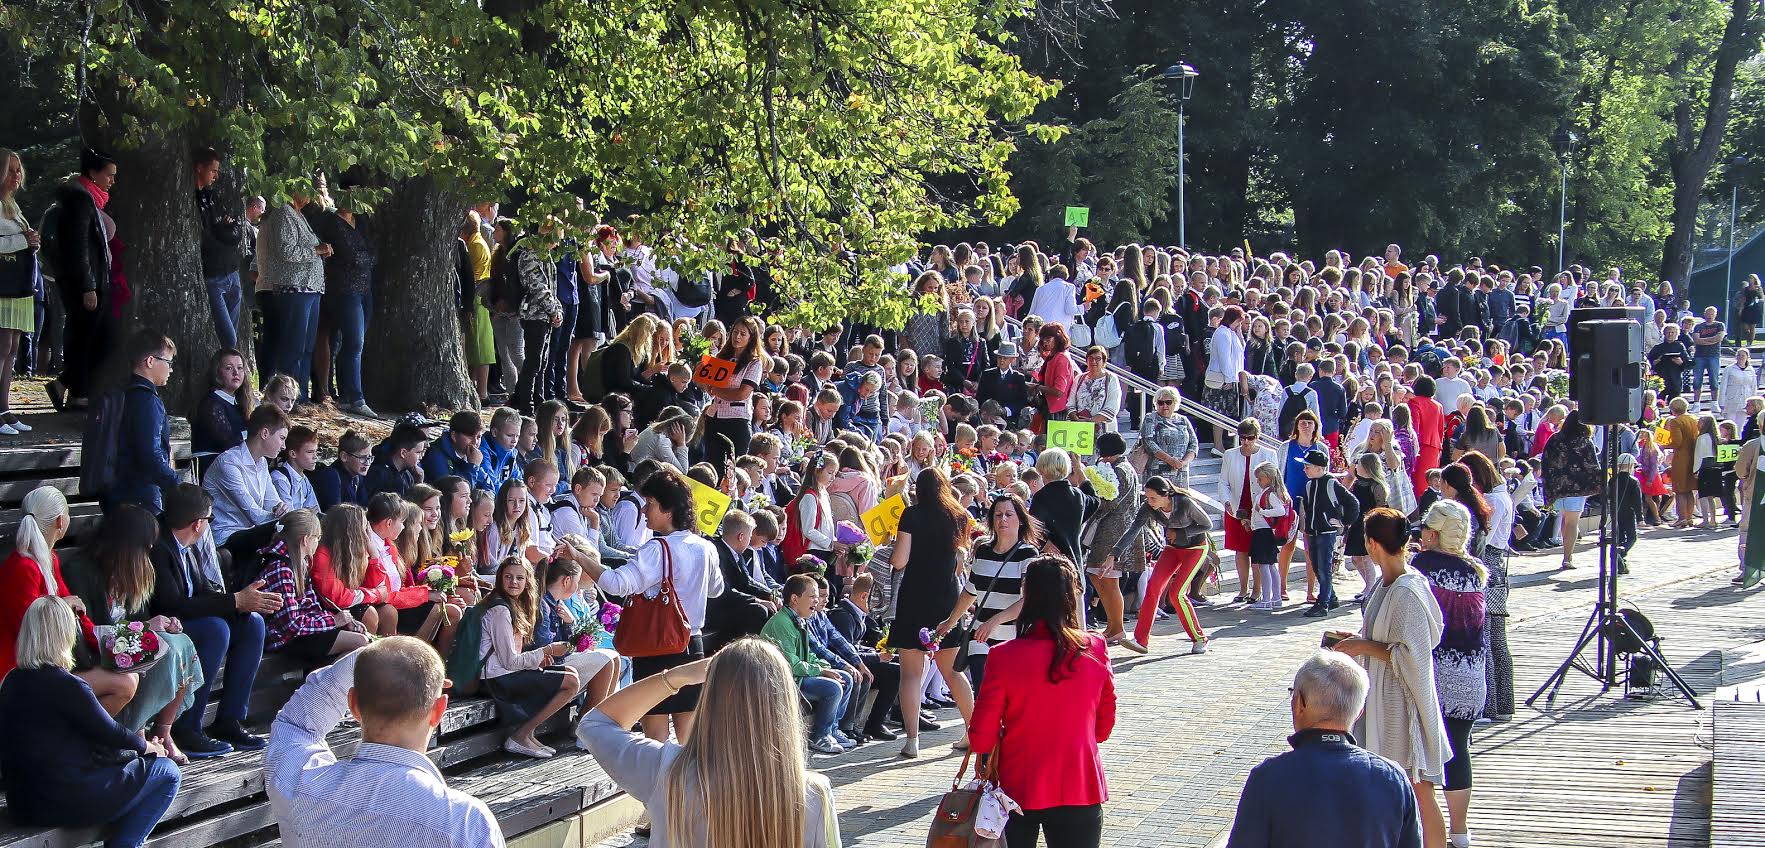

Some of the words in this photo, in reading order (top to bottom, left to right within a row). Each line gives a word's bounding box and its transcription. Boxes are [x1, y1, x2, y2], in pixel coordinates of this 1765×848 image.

[699, 364, 729, 382] 6.D
[1719, 448, 1738, 459] 3.B
[1321, 734, 1341, 742] EOS
